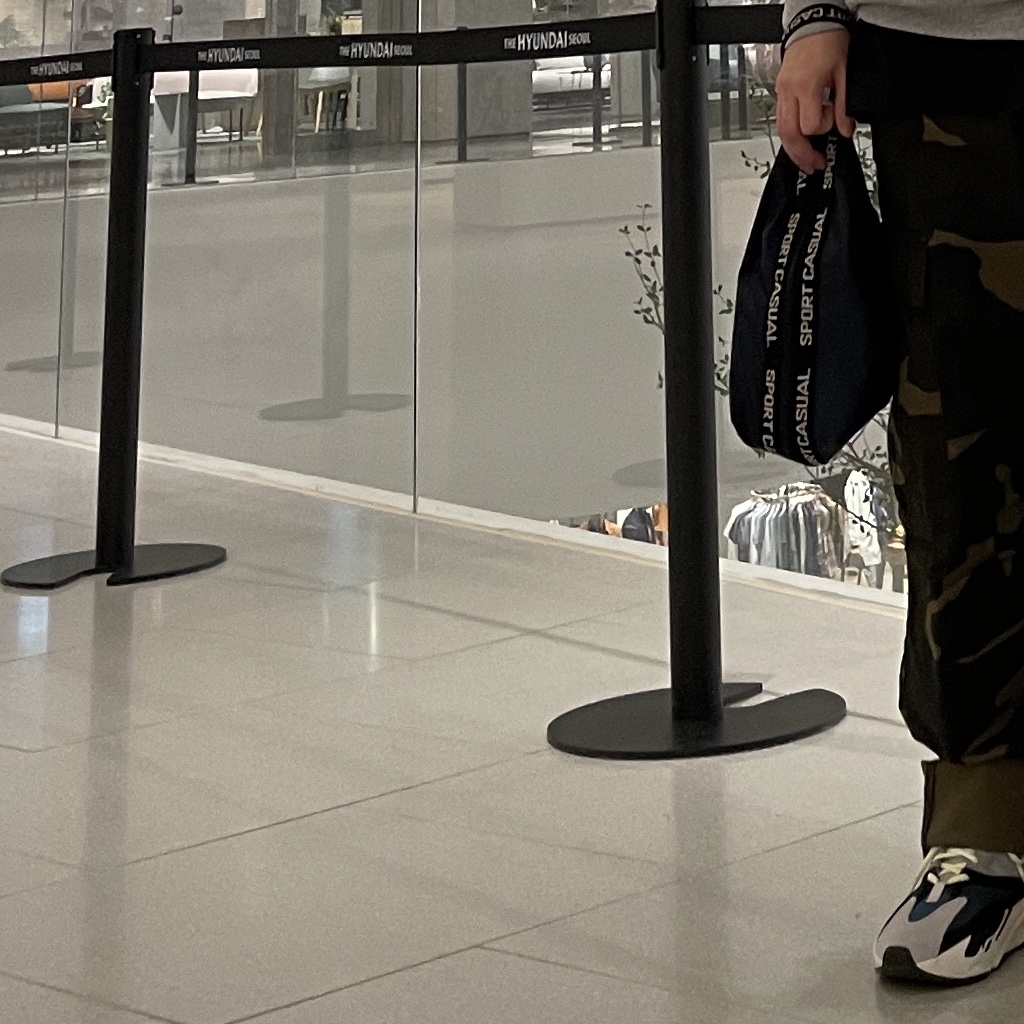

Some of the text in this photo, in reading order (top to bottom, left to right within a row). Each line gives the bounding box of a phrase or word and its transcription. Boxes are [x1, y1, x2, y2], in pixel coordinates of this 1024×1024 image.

[207, 46, 245, 63] HYUNDAI
[350, 41, 393, 59] HYUNDAI
[517, 30, 568, 51] HYUNDAI
[568, 32, 591, 46] SEOUL
[778, 212, 800, 266] SPORT
[802, 207, 828, 281] CASUAL
[766, 268, 785, 348] CASUAL
[800, 283, 814, 347] SPORT
[762, 369, 776, 433] SPORT
[796, 367, 811, 447] CASUAL
